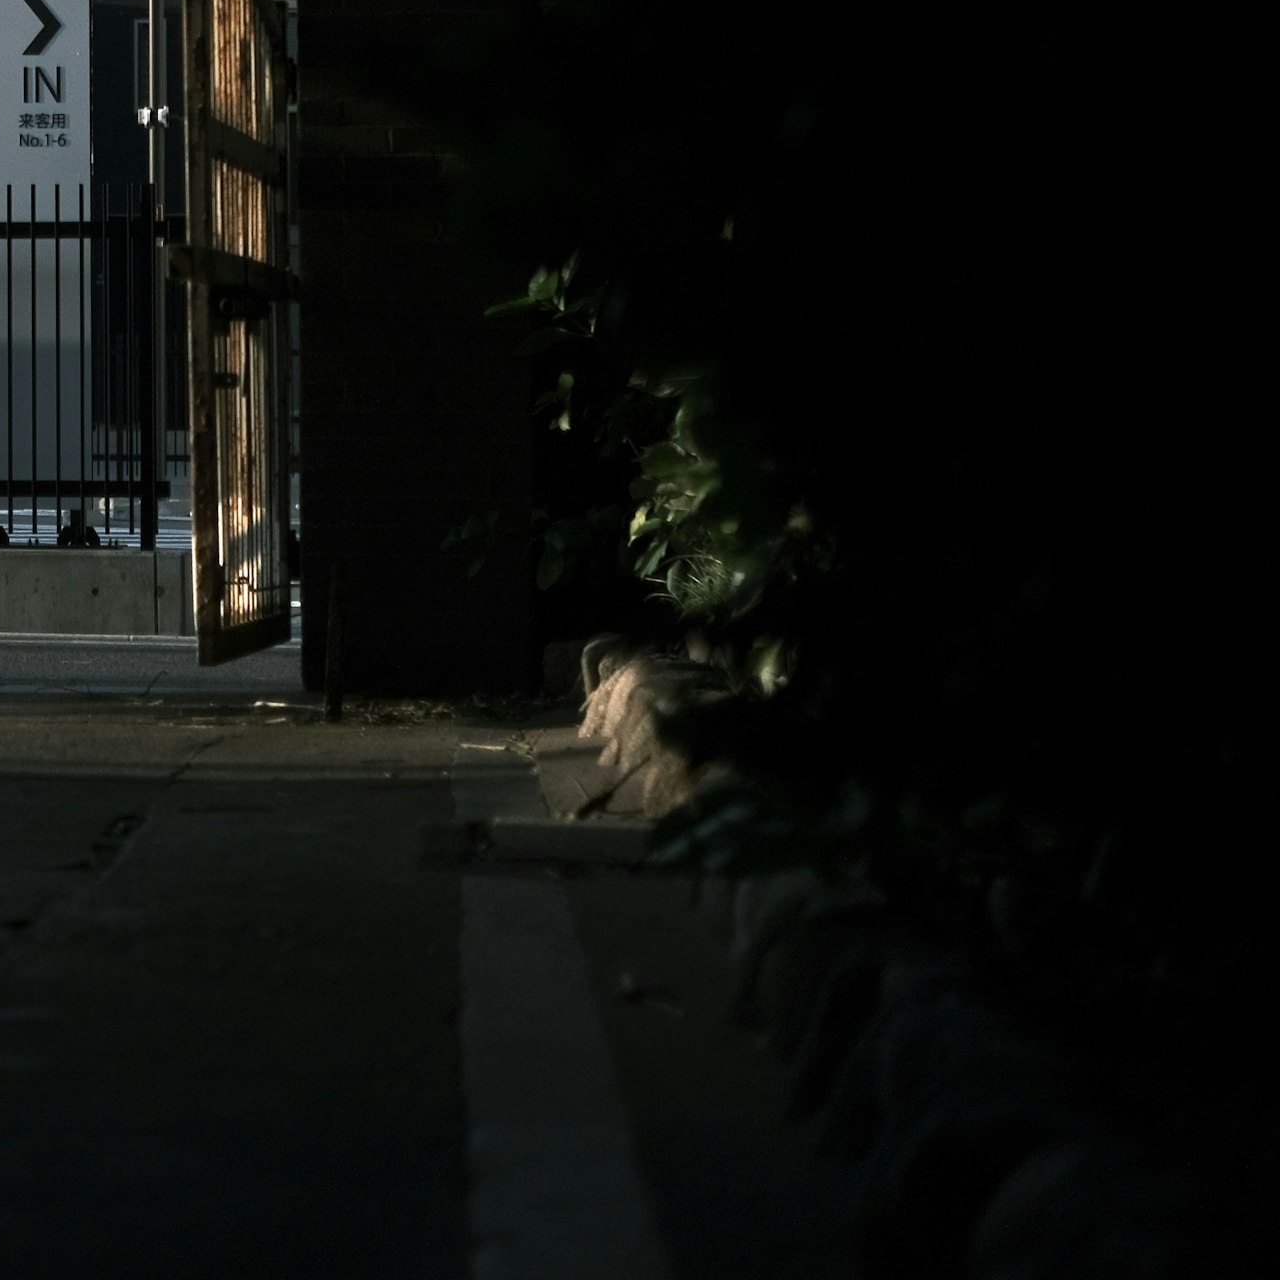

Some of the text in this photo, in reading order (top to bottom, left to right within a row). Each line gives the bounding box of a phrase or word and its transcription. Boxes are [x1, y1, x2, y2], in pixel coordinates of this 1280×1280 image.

[23, 66, 62, 104] IN
[18, 113, 66, 129] 来客用
[19, 133, 67, 147] No.1-6
